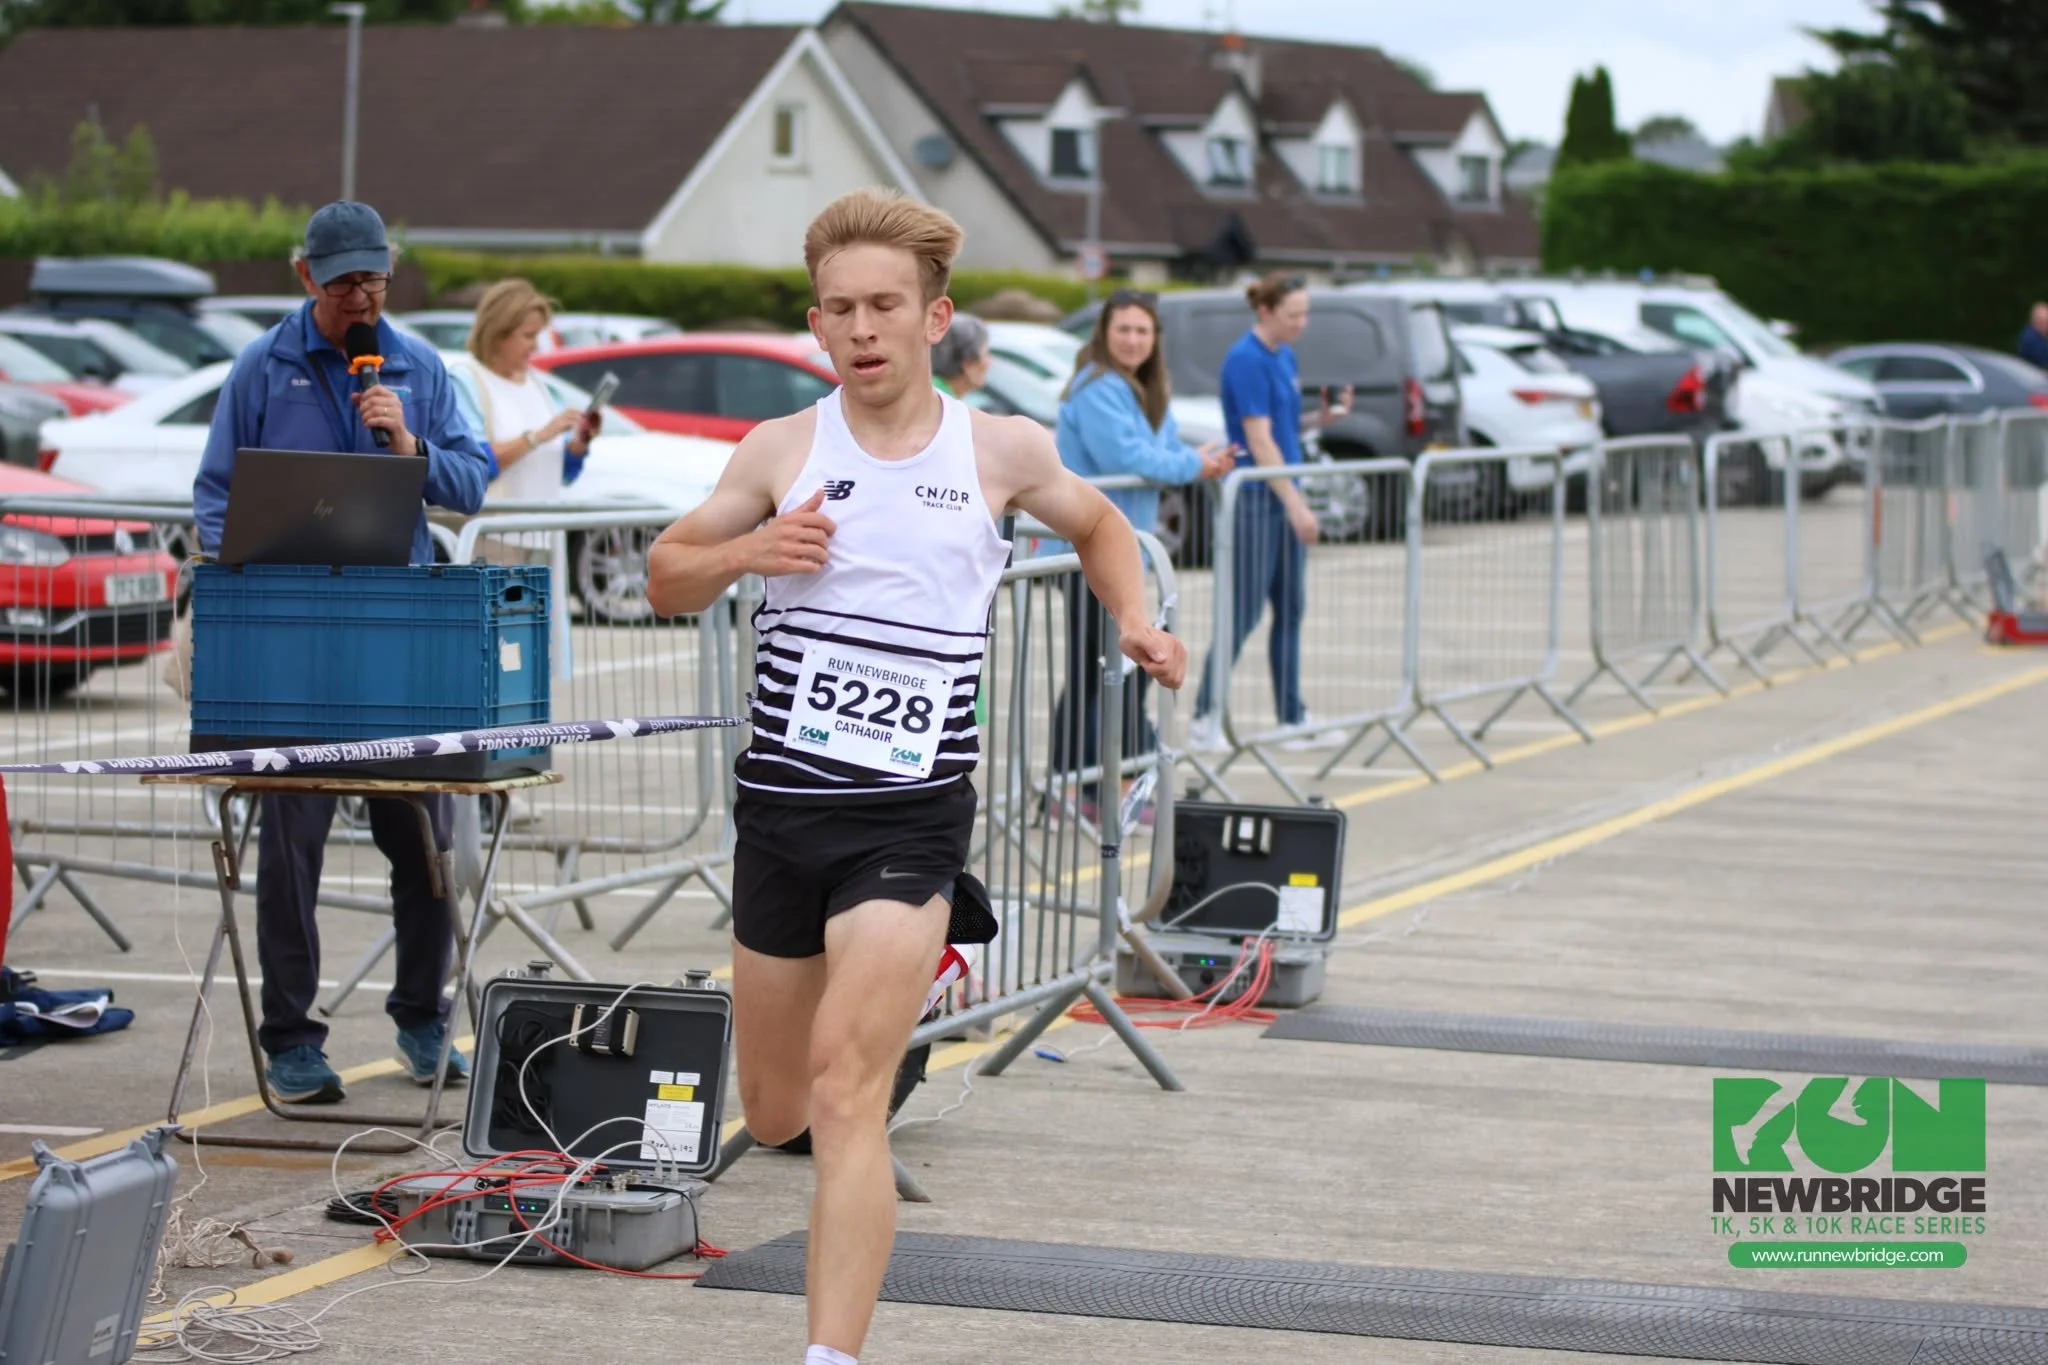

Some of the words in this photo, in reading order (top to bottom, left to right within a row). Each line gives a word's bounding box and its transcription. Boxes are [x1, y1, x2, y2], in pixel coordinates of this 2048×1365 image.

[915, 485, 970, 505] CN/DR
[922, 500, 944, 509] TRACK
[945, 503, 963, 512] CLUB
[828, 657, 854, 673] RUN
[855, 663, 928, 690] NEWBRIDGE
[807, 672, 934, 734] 5228
[834, 720, 894, 744] CATHAOIR
[152, 751, 234, 768] CHALLENGE
[296, 746, 342, 764] CROSS
[342, 741, 416, 761] CHALLENGE
